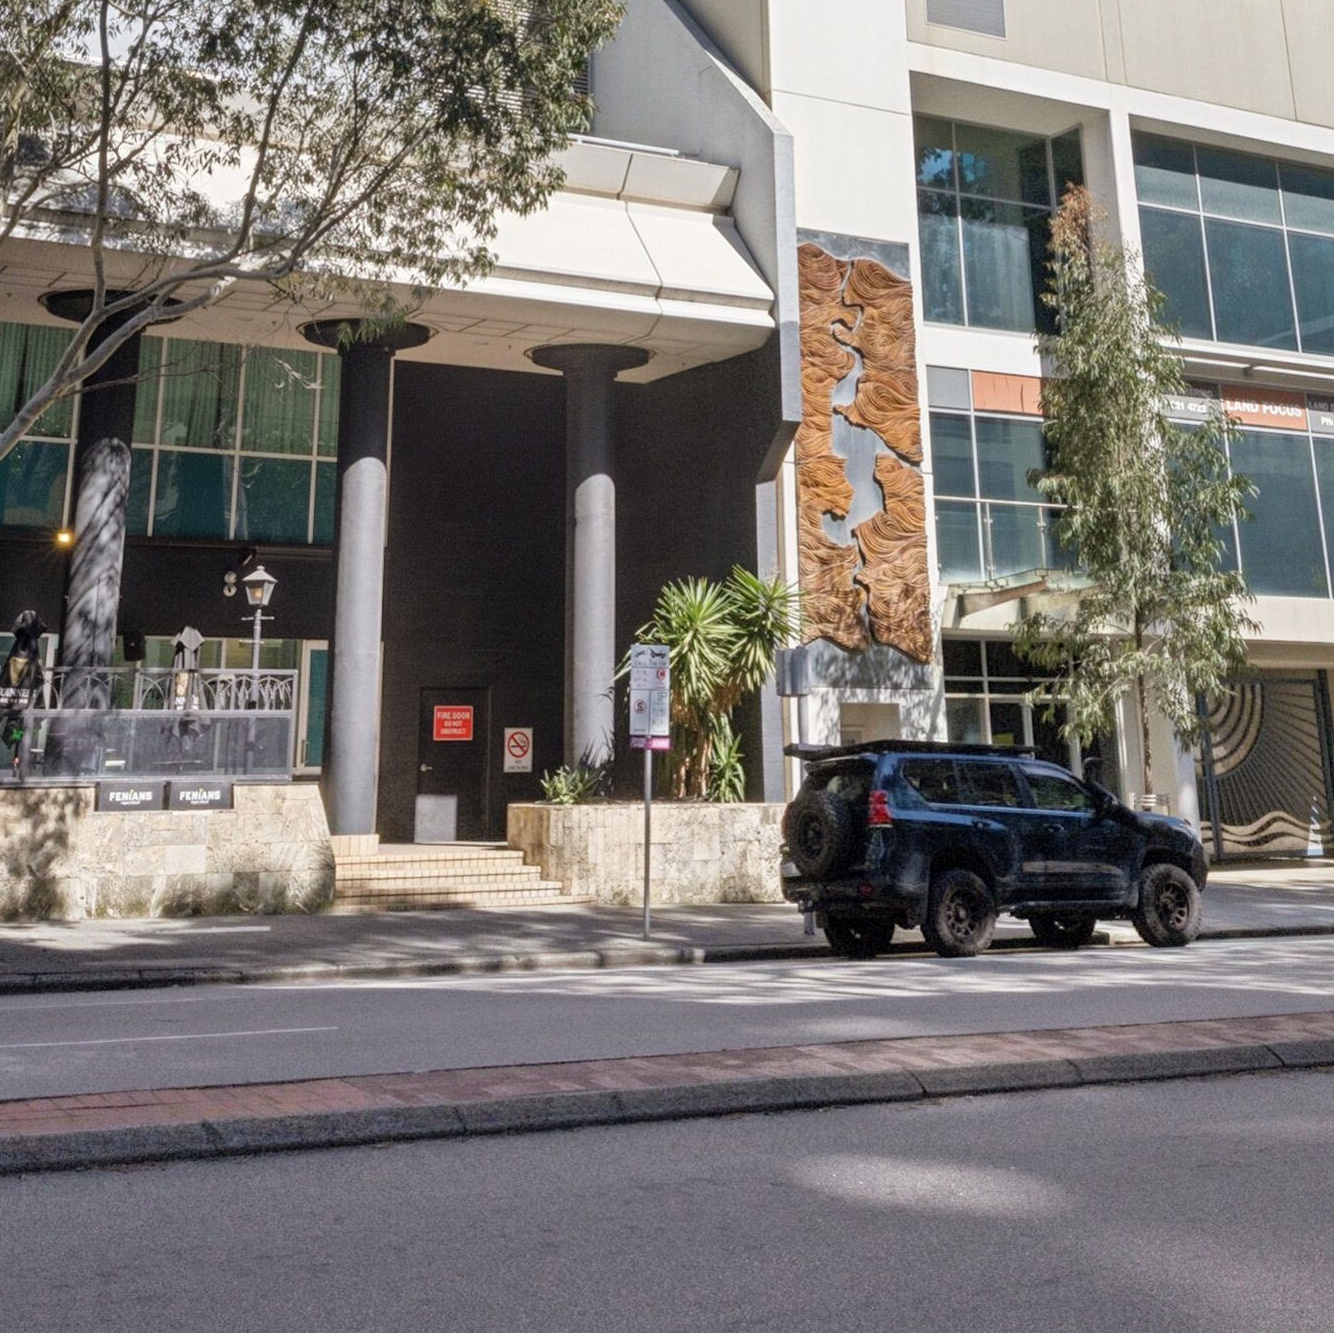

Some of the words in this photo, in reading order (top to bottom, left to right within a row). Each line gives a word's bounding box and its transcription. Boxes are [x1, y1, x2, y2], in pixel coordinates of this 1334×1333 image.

[1226, 399, 1259, 413] LAND
[1262, 402, 1303, 418] FOCUS
[1308, 401, 1329, 411] LAND
[437, 712, 451, 720] FIRE
